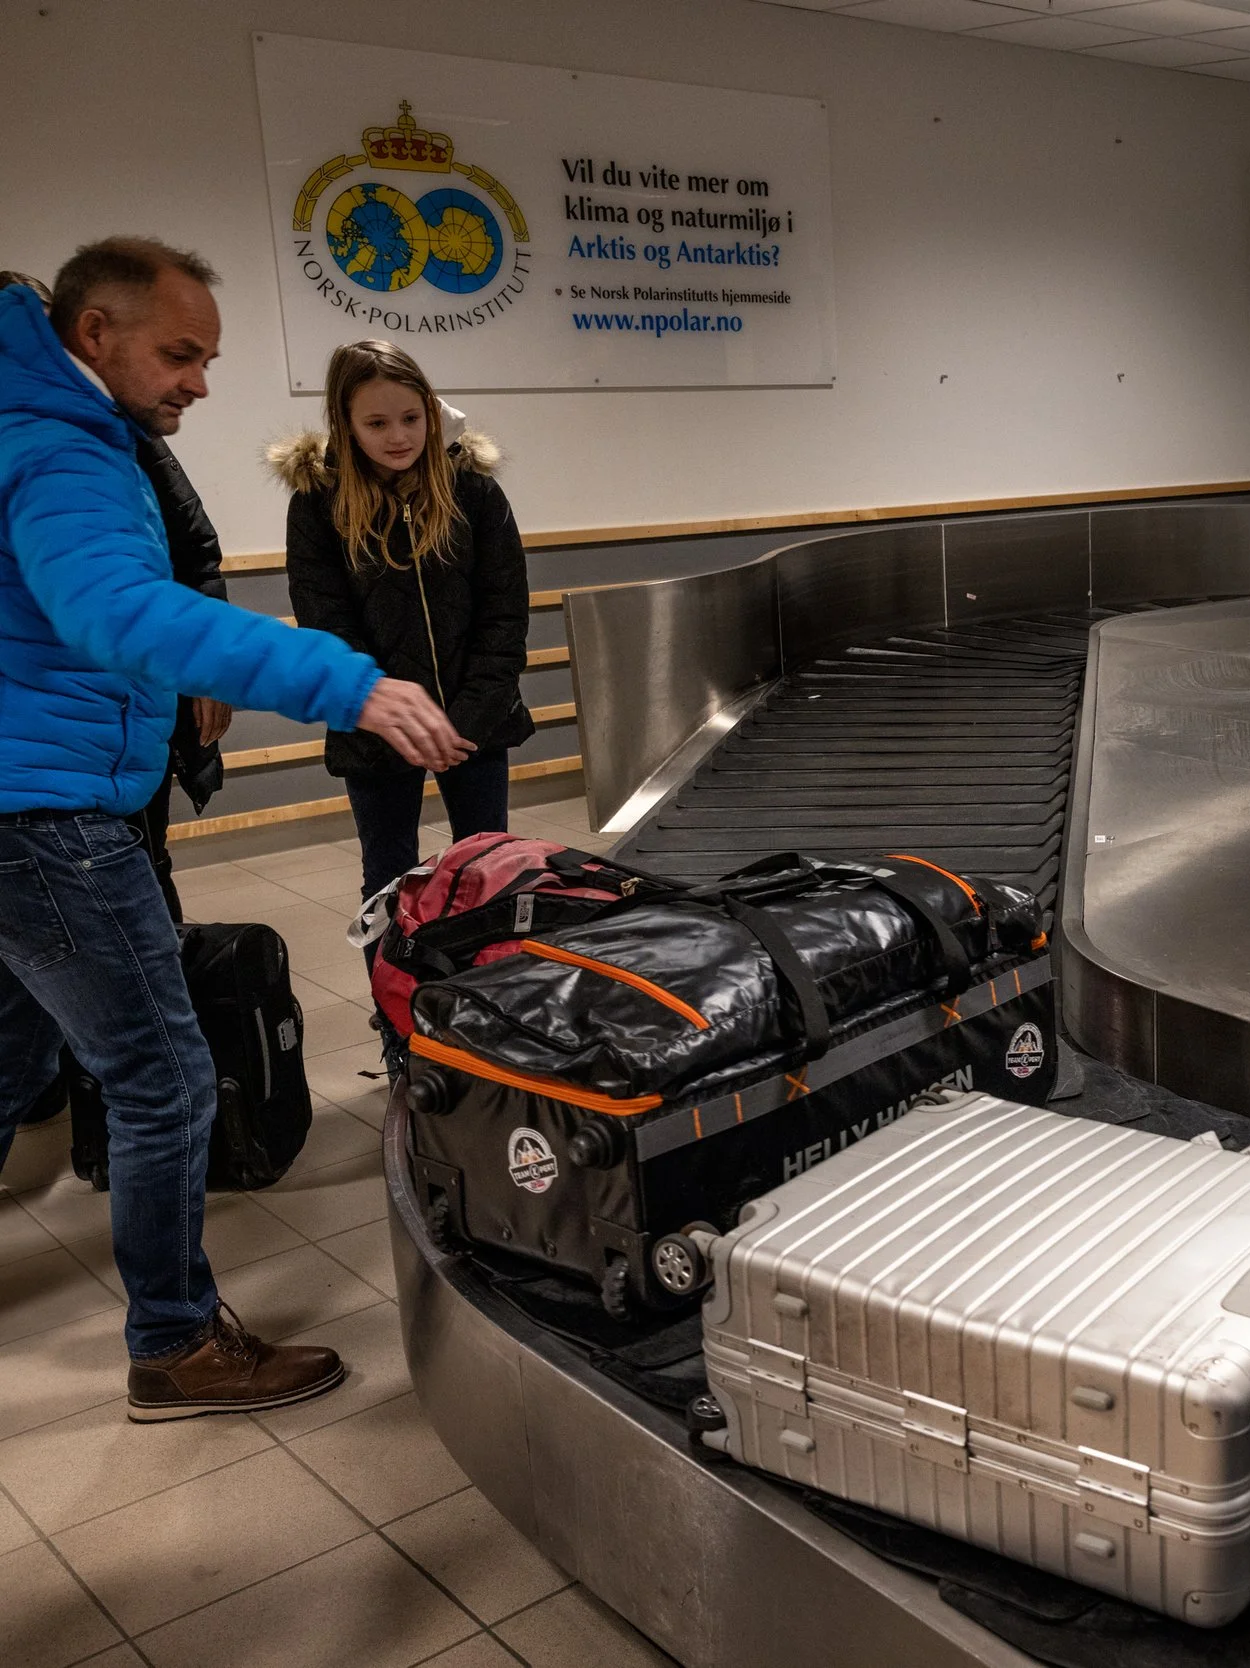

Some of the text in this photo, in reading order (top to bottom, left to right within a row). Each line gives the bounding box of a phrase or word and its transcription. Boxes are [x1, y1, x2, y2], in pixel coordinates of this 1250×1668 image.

[562, 158, 769, 197] Vil du vite mer om
[565, 195, 793, 239] klima og naturmiljø i
[568, 234, 780, 270] Arktis og Antarktis?
[294, 239, 532, 333] NORSK POLARINSTITUTT
[570, 284, 791, 306] Se Norsk Polarinstitutts hjemmeside
[572, 307, 743, 338] www.npolar.no
